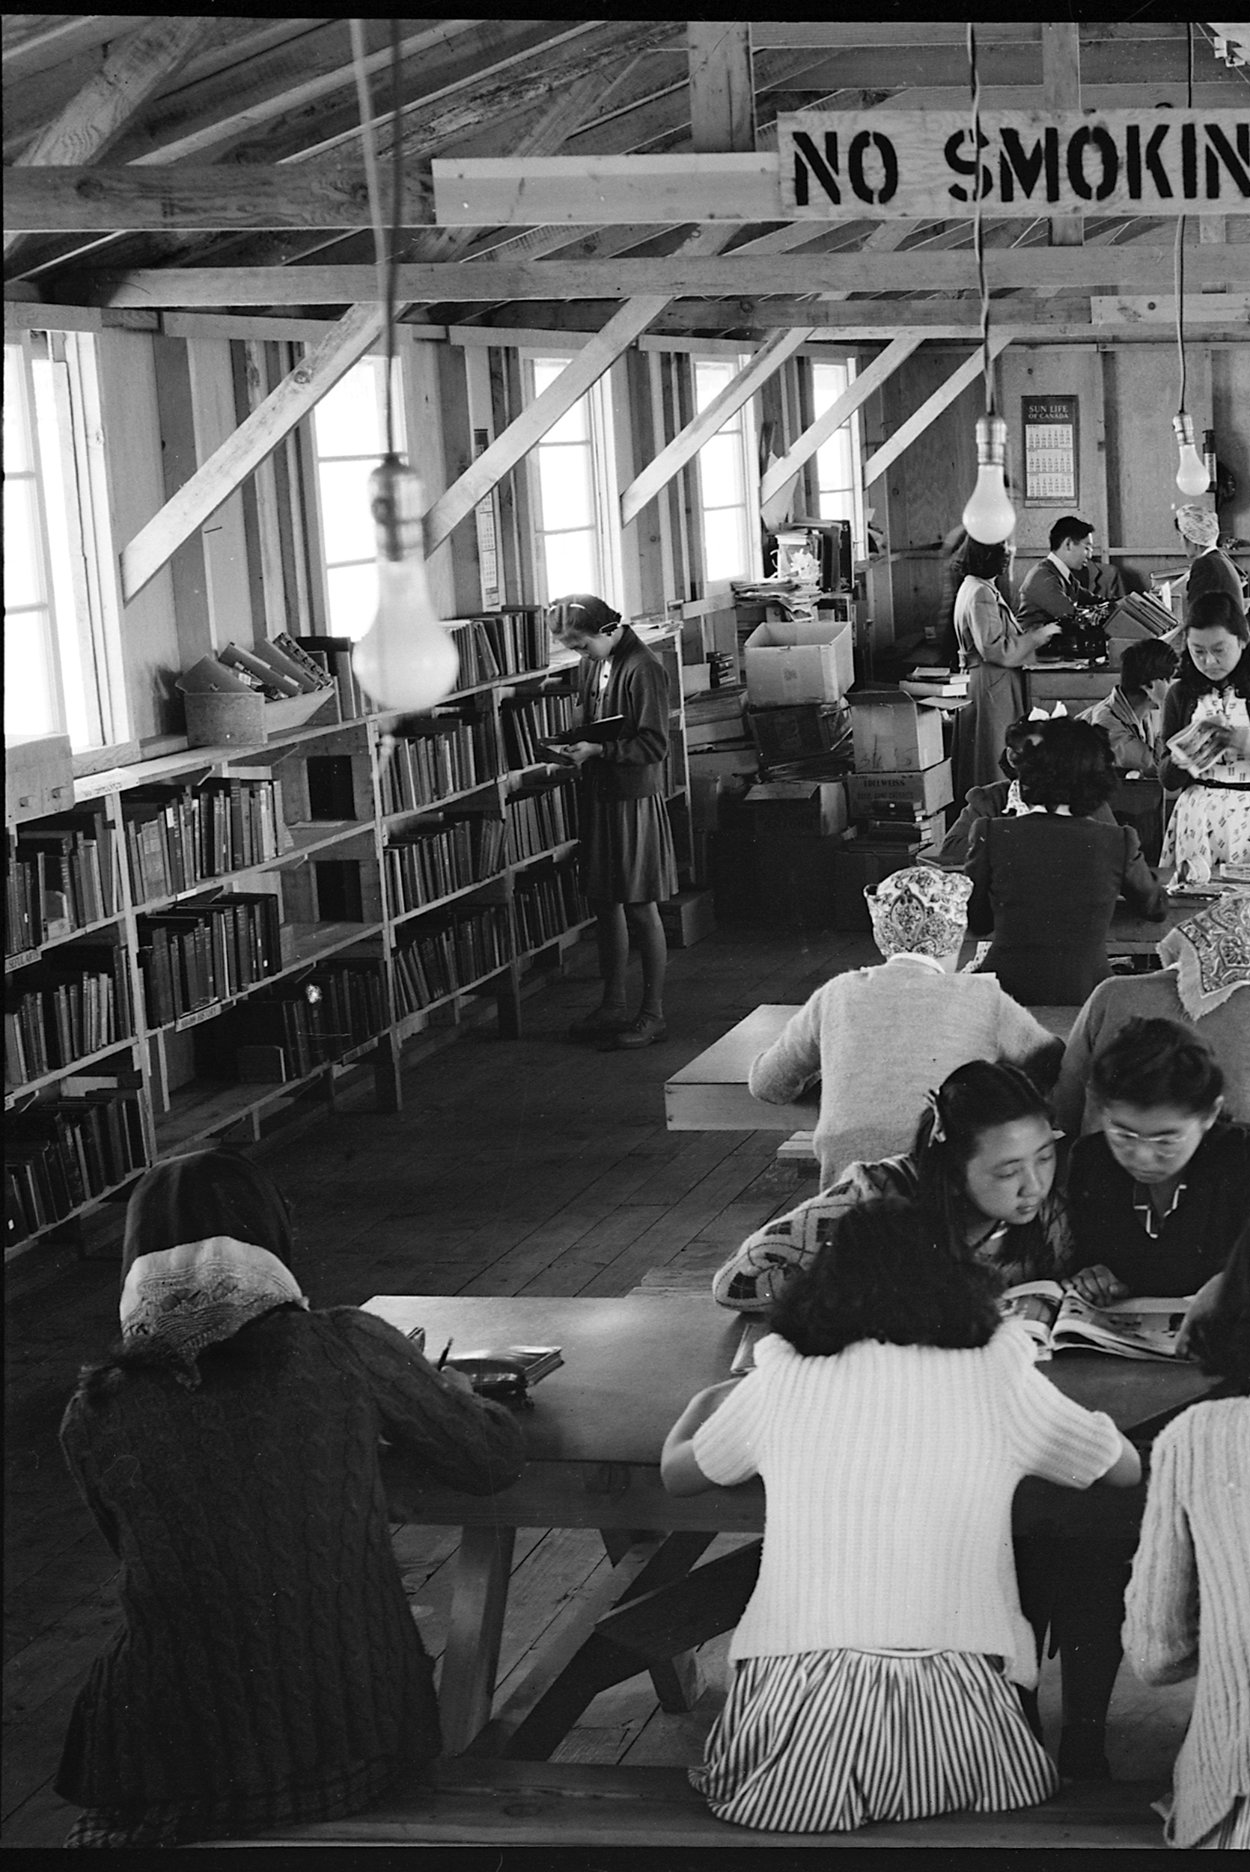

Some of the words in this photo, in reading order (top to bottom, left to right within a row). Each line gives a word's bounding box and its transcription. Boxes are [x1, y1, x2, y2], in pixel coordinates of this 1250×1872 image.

[793, 130, 898, 206] NO
[1028, 405, 1046, 413] SUN
[1049, 404, 1069, 413] LIFE
[1039, 412, 1069, 420] CANADA
[863, 780, 906, 788] EDELWEISS
